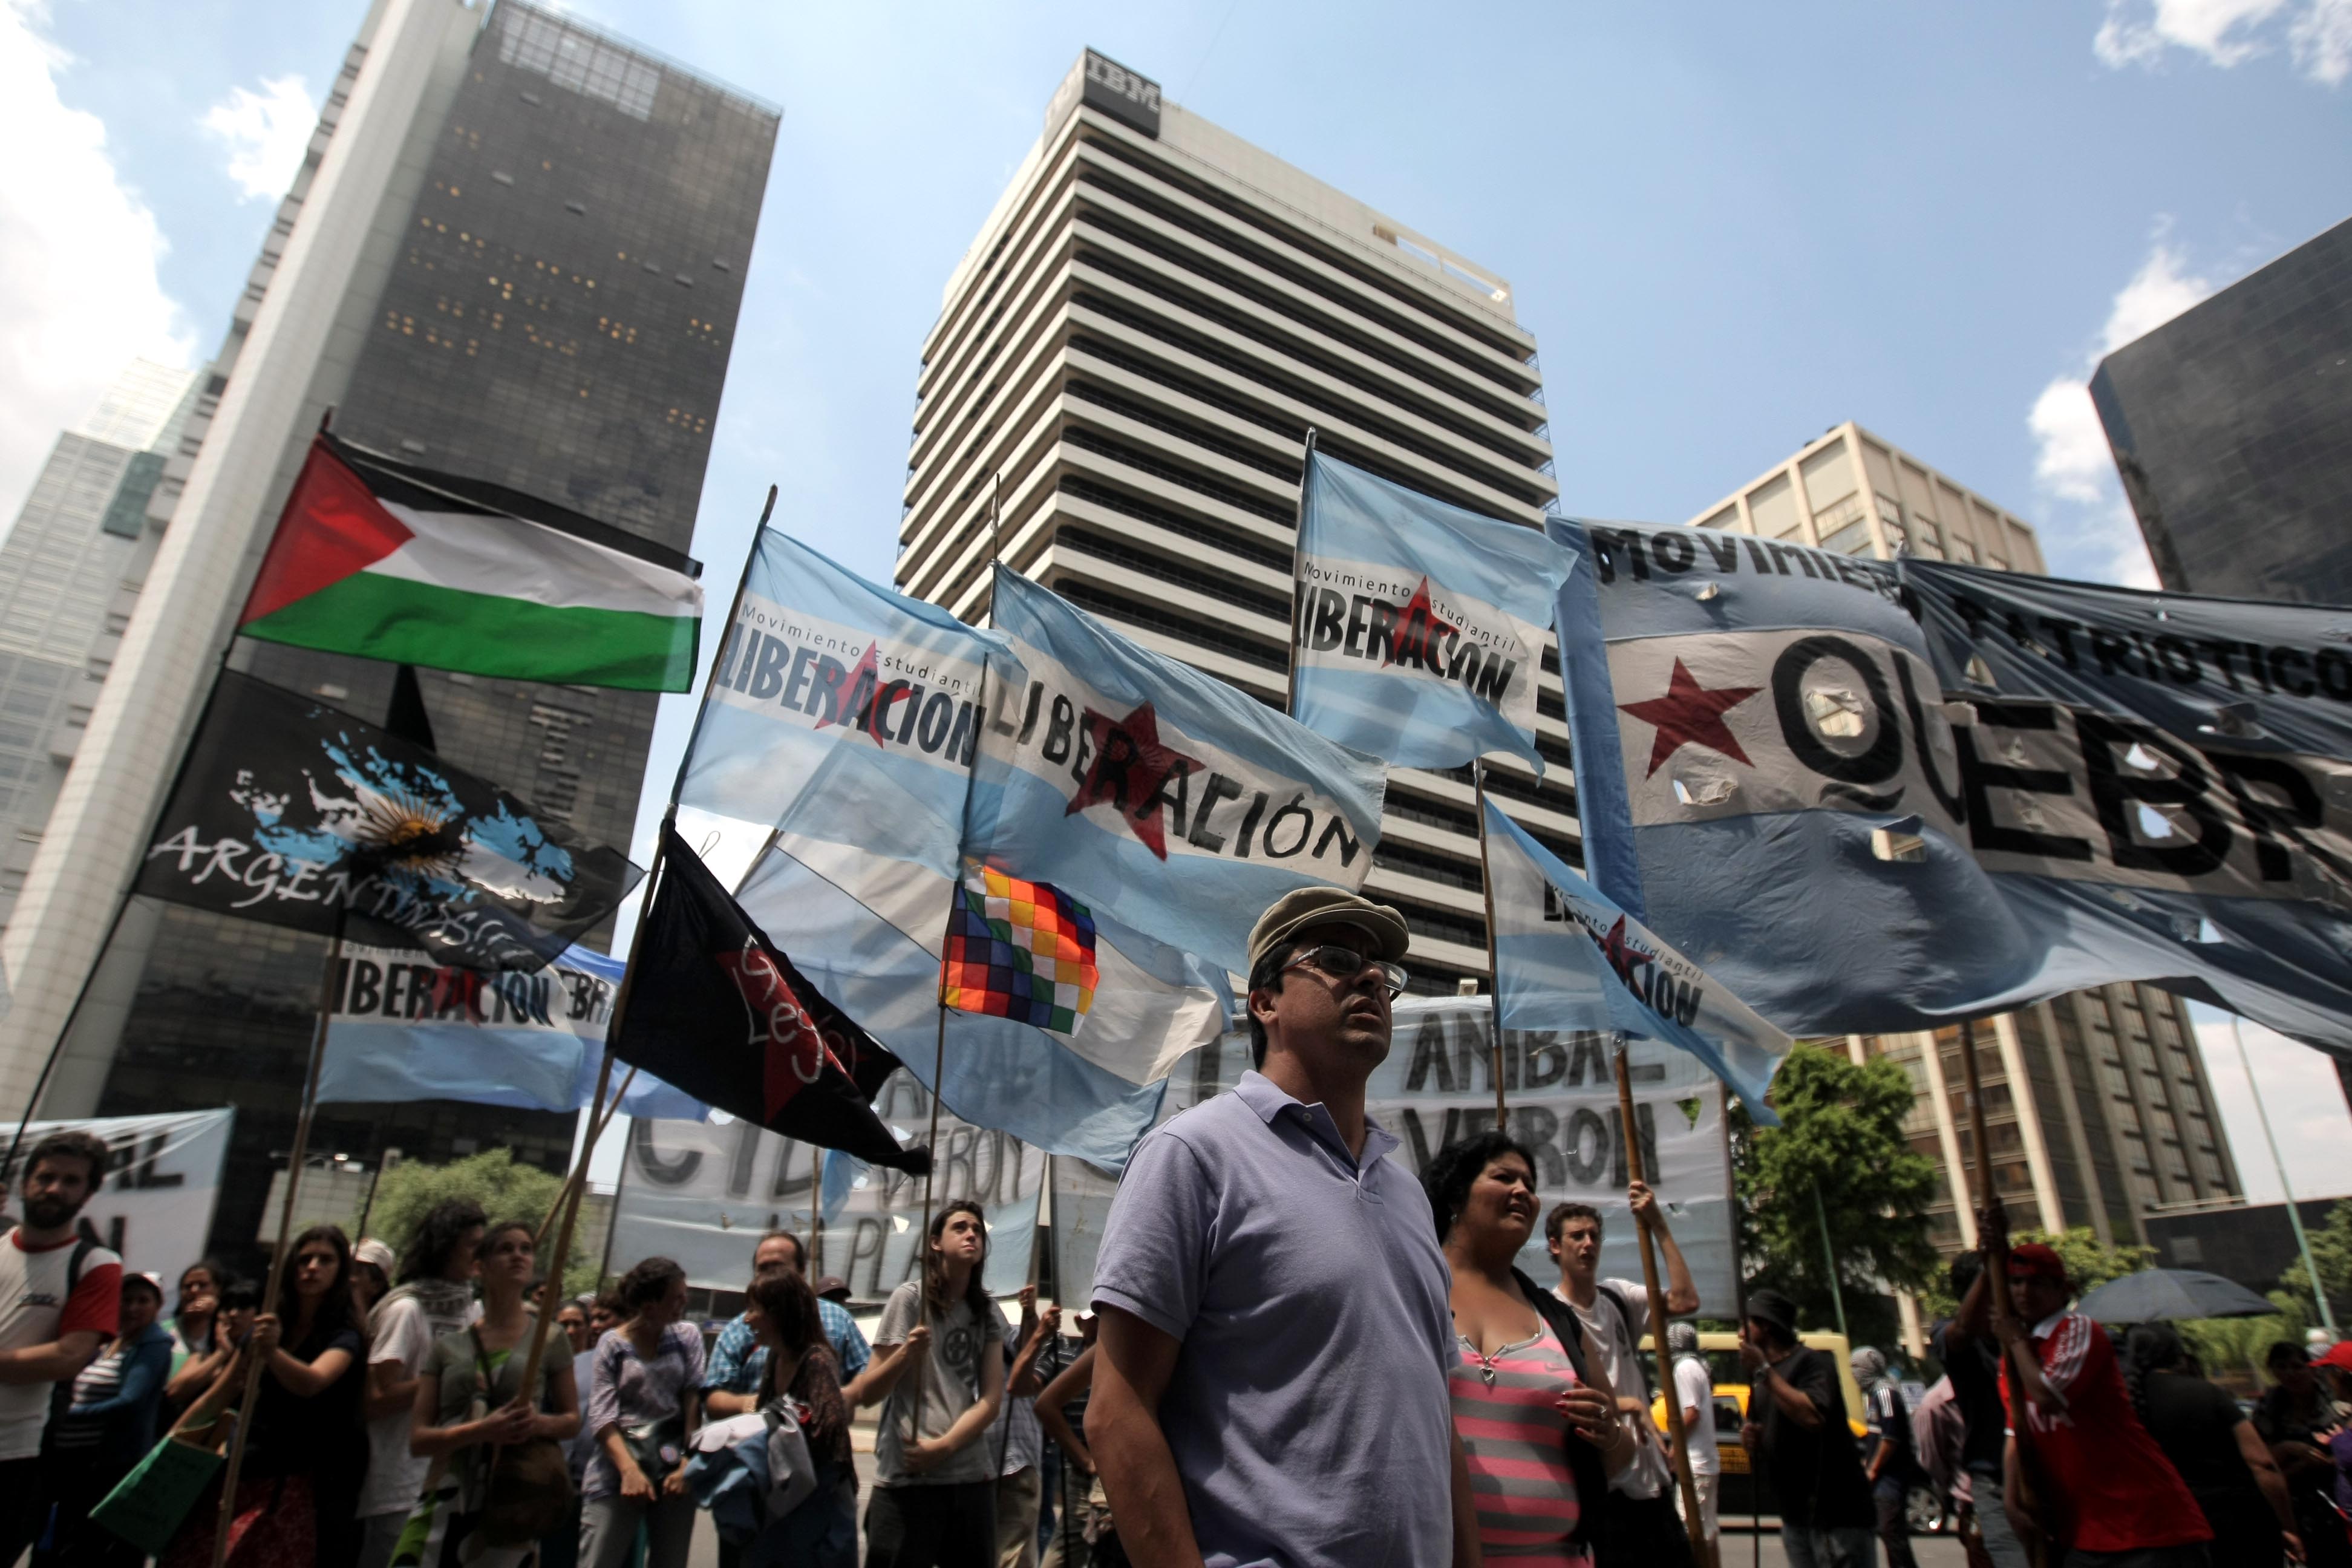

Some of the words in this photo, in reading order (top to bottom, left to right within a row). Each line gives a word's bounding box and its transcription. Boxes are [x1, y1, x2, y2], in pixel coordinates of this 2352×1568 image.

[1086, 51, 1160, 113] IBM
[1304, 561, 1411, 598] Movimiento
[742, 603, 860, 657] Movimiento
[715, 622, 987, 767] LIBERACIÓN
[981, 676, 1360, 867] LIBERACIÓN
